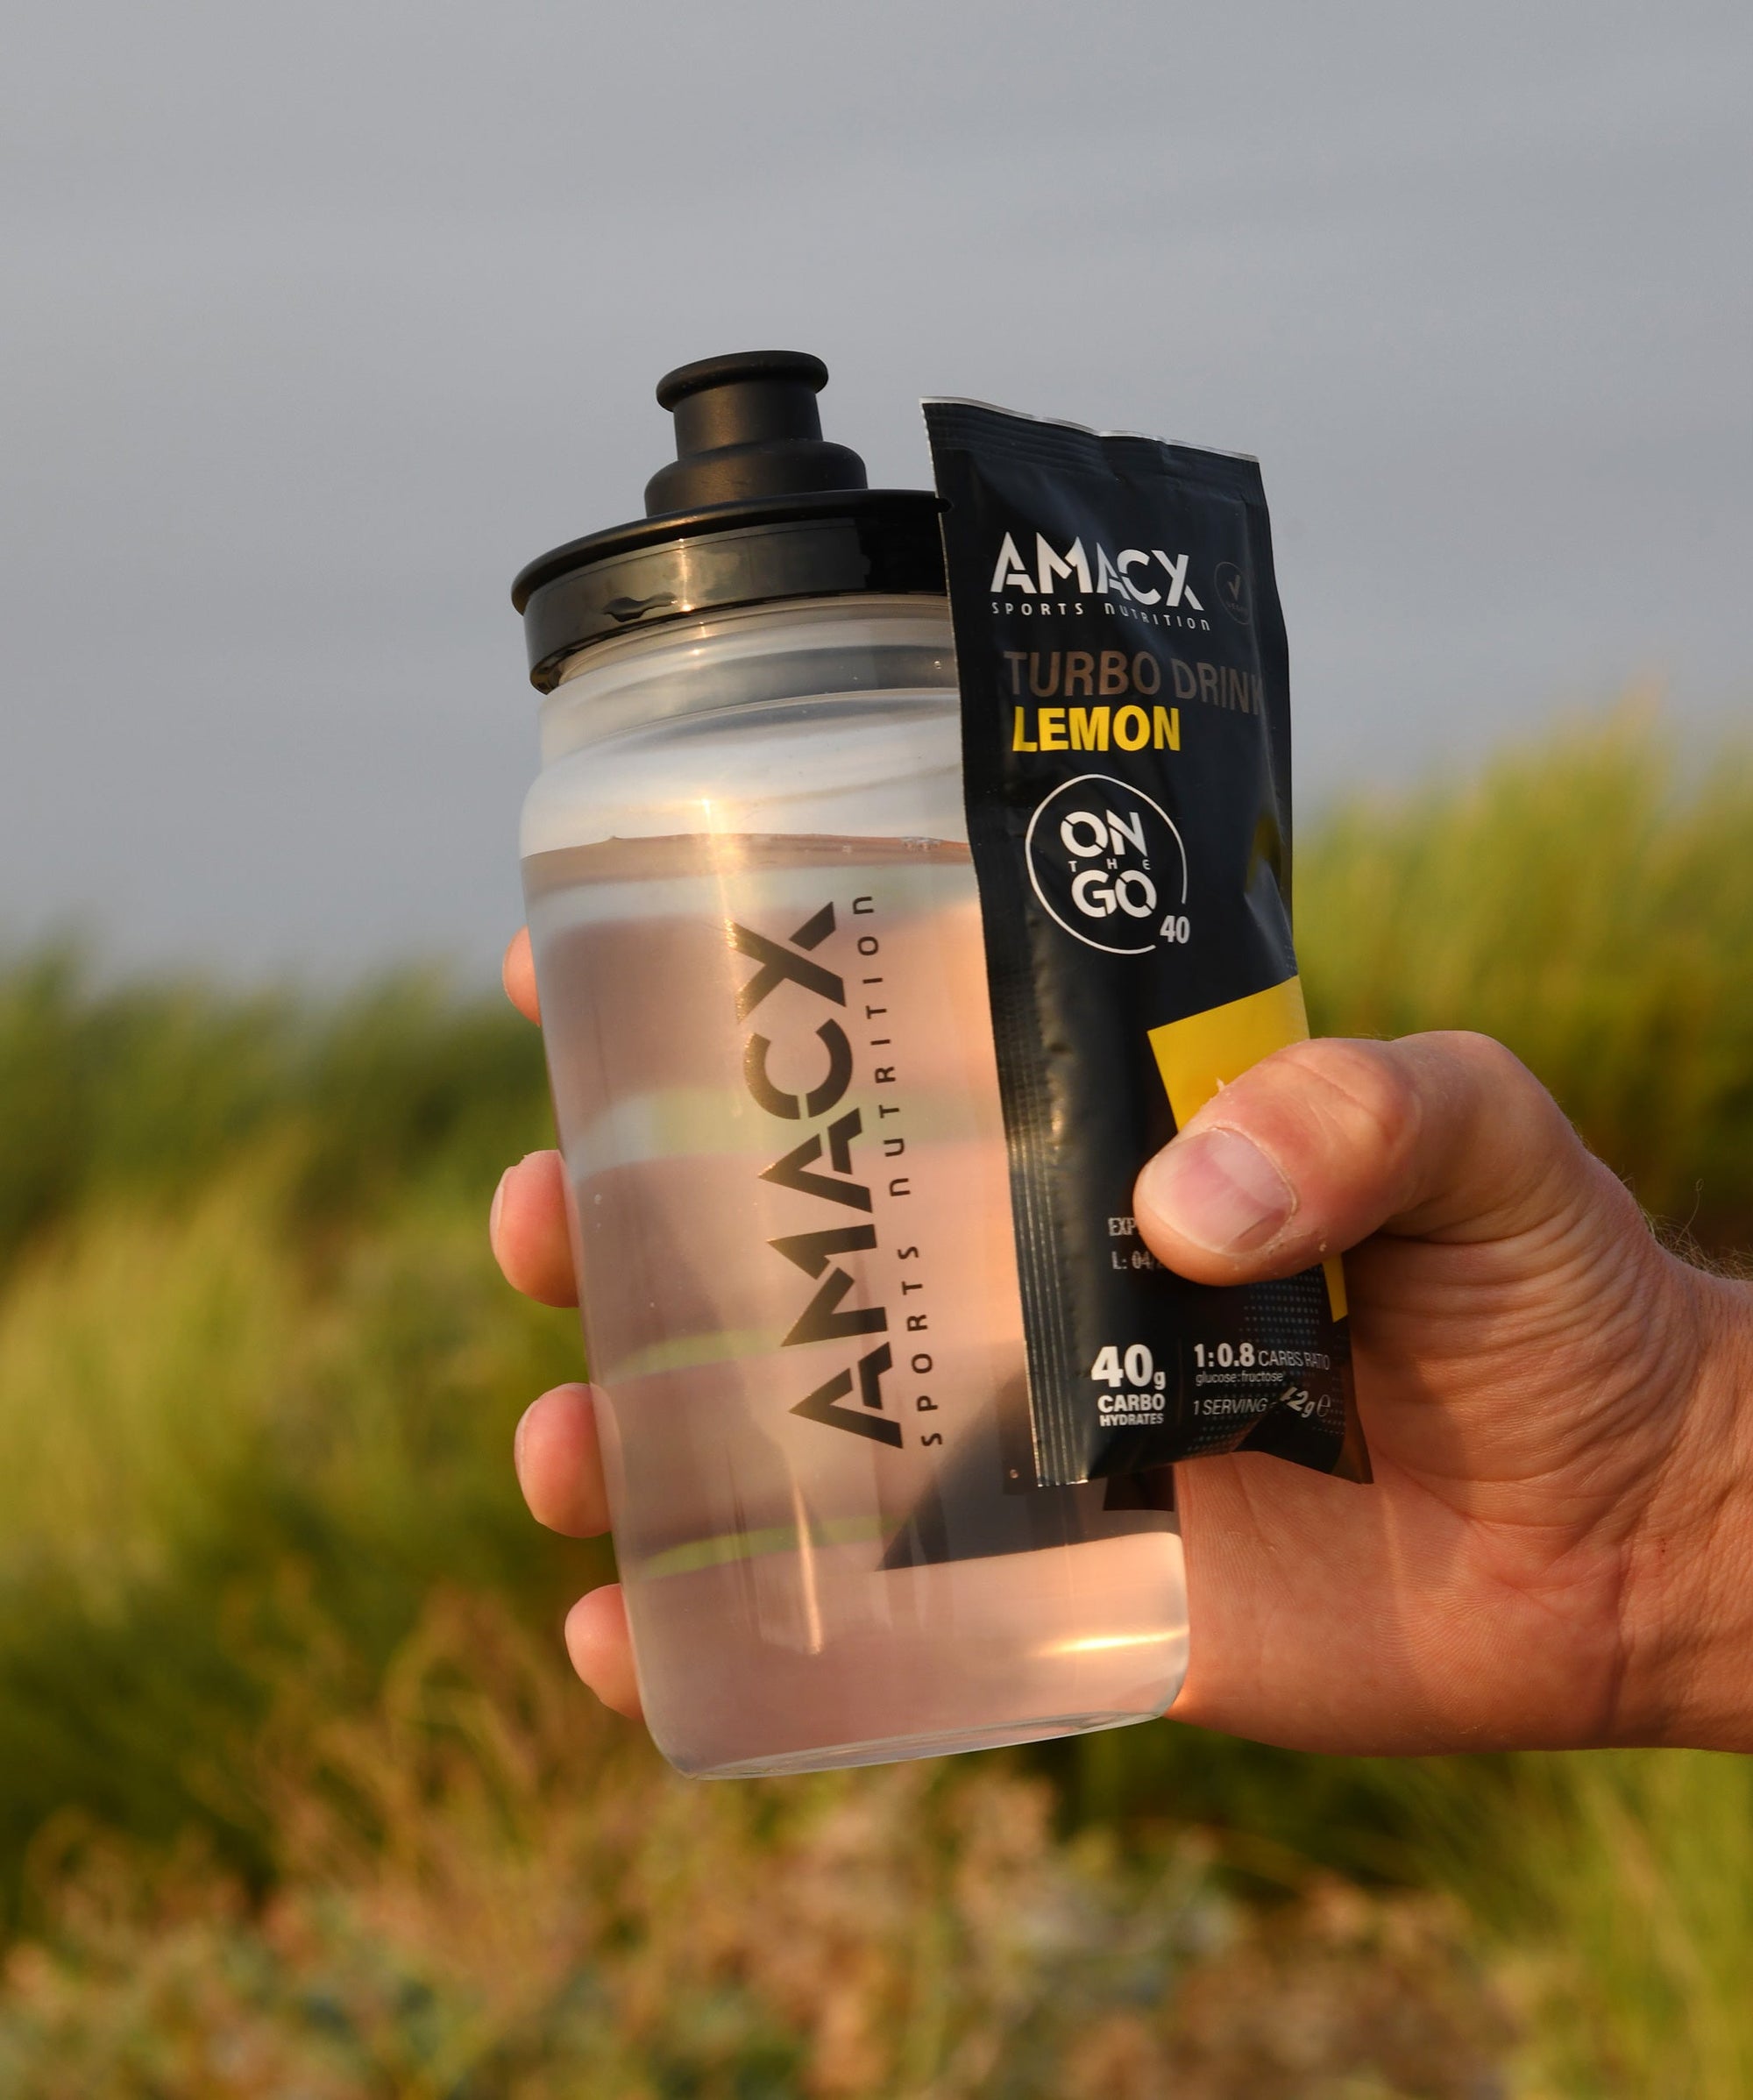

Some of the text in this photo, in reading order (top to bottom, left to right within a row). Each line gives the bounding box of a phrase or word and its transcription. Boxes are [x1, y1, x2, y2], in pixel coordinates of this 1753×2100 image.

[990, 531, 1204, 611] AMACX
[991, 601, 1083, 616] SPORTS
[1104, 603, 1210, 631] NUTRITION
[1003, 650, 1264, 716] TURBO DRINK
[1012, 705, 1181, 752] LEMON
[1060, 809, 1148, 858] ON
[1068, 857, 1152, 873] THE
[1071, 869, 1157, 919] GO
[1160, 914, 1190, 944] 40
[725, 901, 904, 1449] AMACX
[852, 896, 943, 1446] SPORTS NUTRITION
[1090, 1343, 1167, 1391] 40g
[1194, 1342, 1331, 1371] 1:0.8 CARBS RATIO
[1097, 1393, 1167, 1414] CARBO
[1098, 1412, 1165, 1427] HYDRATES
[1193, 1400, 1200, 1415] 1
[1203, 1397, 1268, 1415] SERVING
